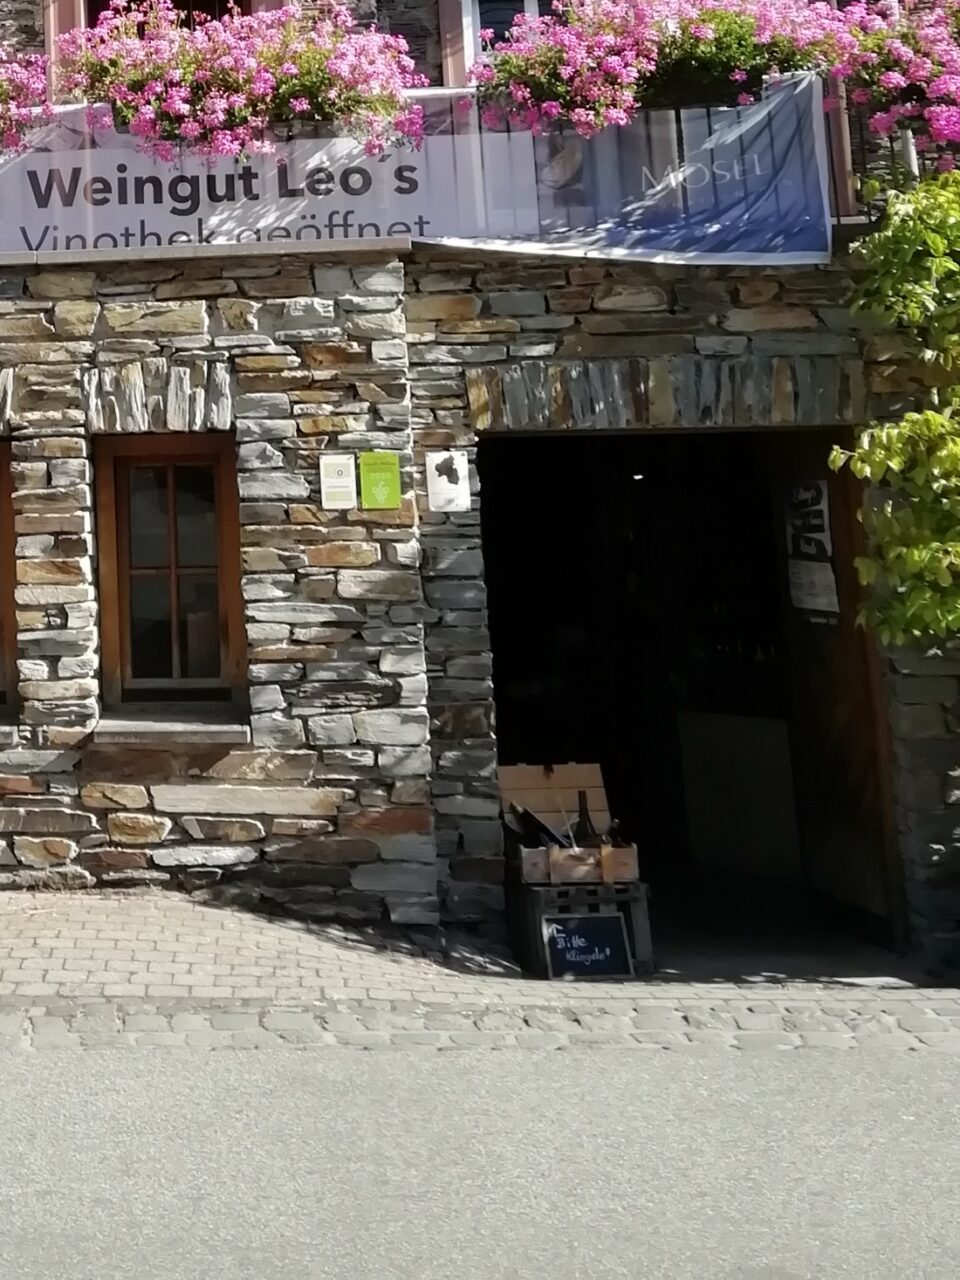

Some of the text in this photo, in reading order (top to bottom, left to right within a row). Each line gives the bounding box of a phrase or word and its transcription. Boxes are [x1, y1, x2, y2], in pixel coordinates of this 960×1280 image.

[26, 163, 260, 217] Weingut
[641, 153, 770, 192] MOSEL
[19, 217, 216, 251] Vinothek
